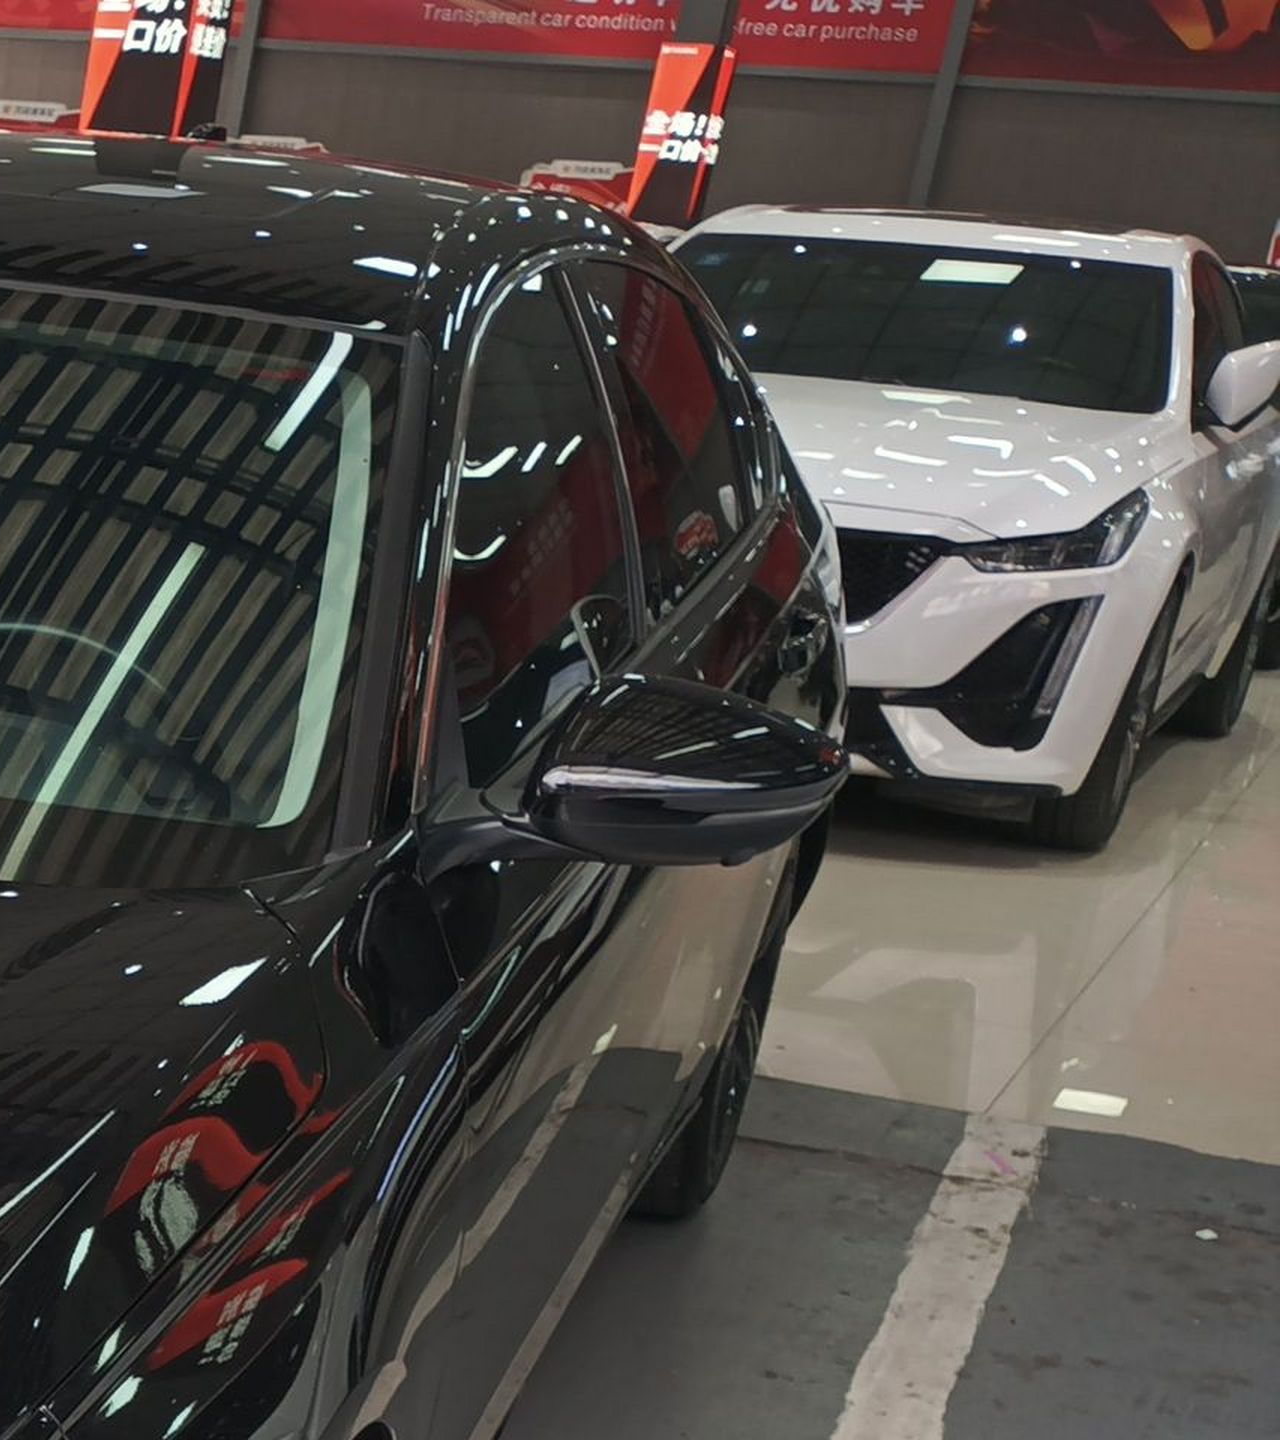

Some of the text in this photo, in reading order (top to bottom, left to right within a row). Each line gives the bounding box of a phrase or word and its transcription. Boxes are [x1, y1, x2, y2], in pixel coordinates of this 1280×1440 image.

[423, 4, 537, 26] Transparent
[540, 13, 571, 28] car
[575, 13, 665, 32] condition
[783, 21, 818, 38] car
[820, 22, 919, 43] purchase
[92, 18, 188, 54] 一口价
